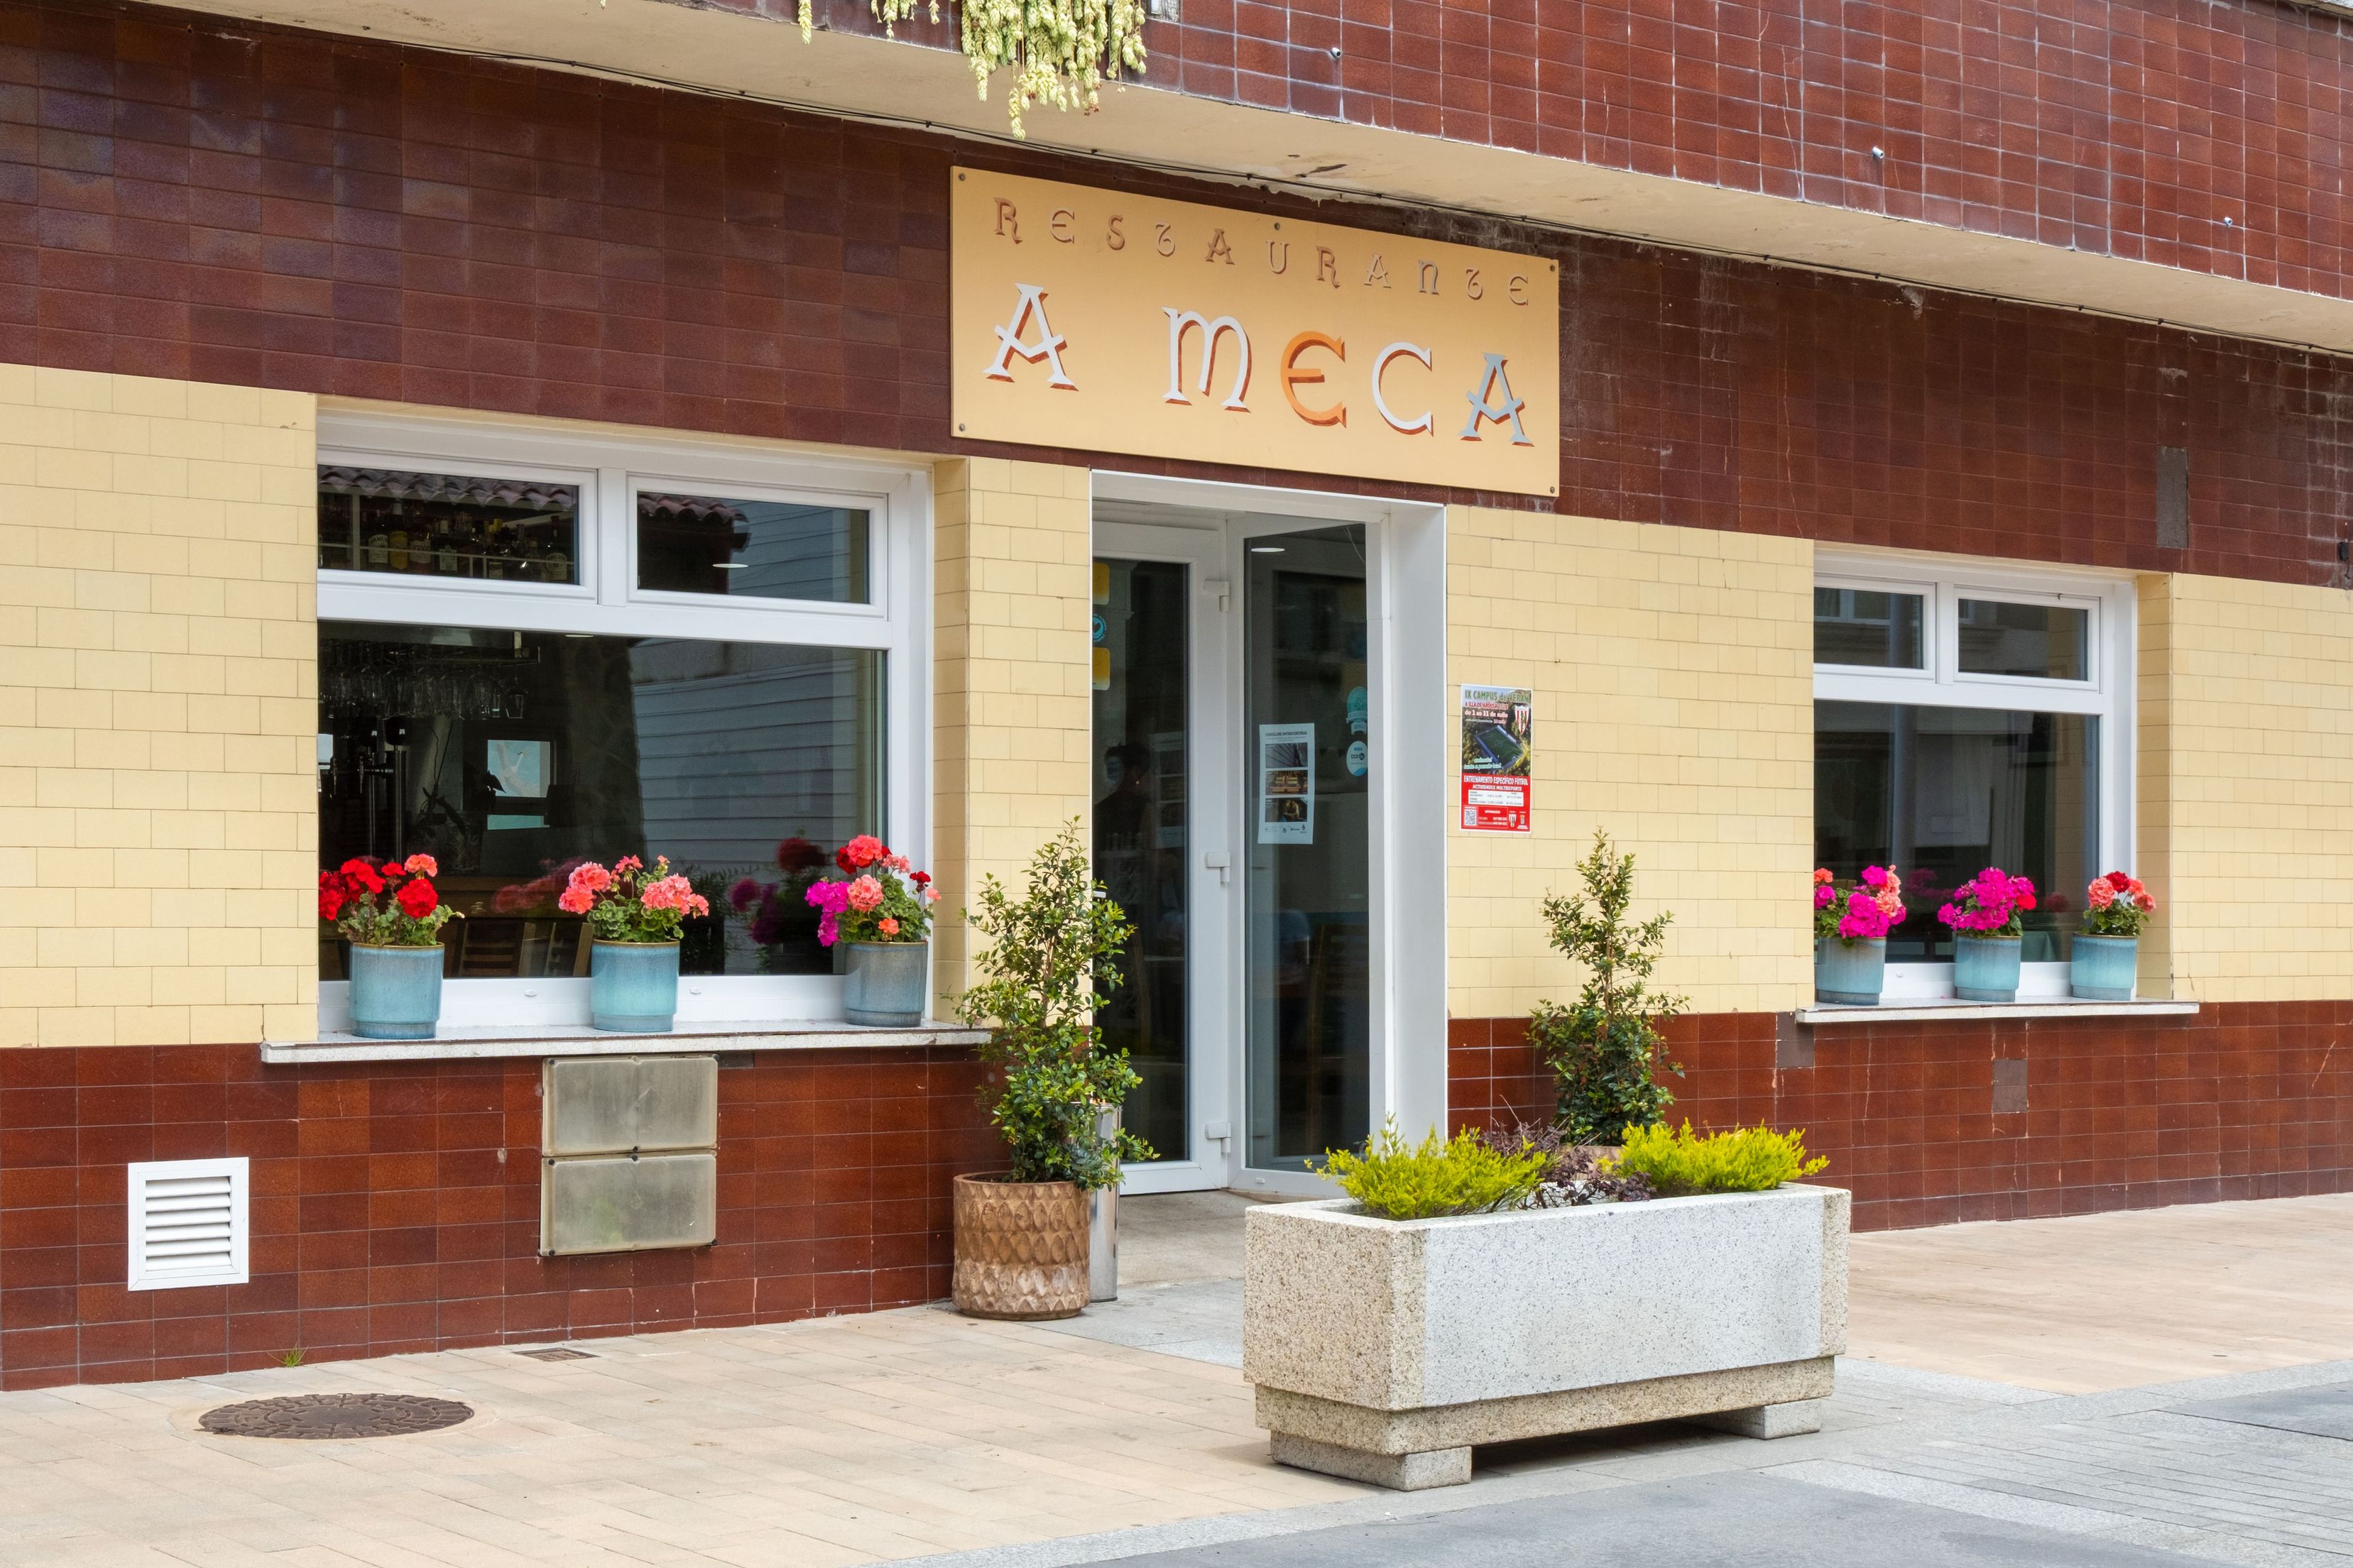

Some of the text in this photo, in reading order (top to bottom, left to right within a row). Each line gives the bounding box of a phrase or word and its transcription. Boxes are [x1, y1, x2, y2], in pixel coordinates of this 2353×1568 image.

[993, 197, 1529, 307] RESTAURANTE
[983, 283, 1534, 447] A MECA
[1473, 691, 1497, 700] CAMPUS
